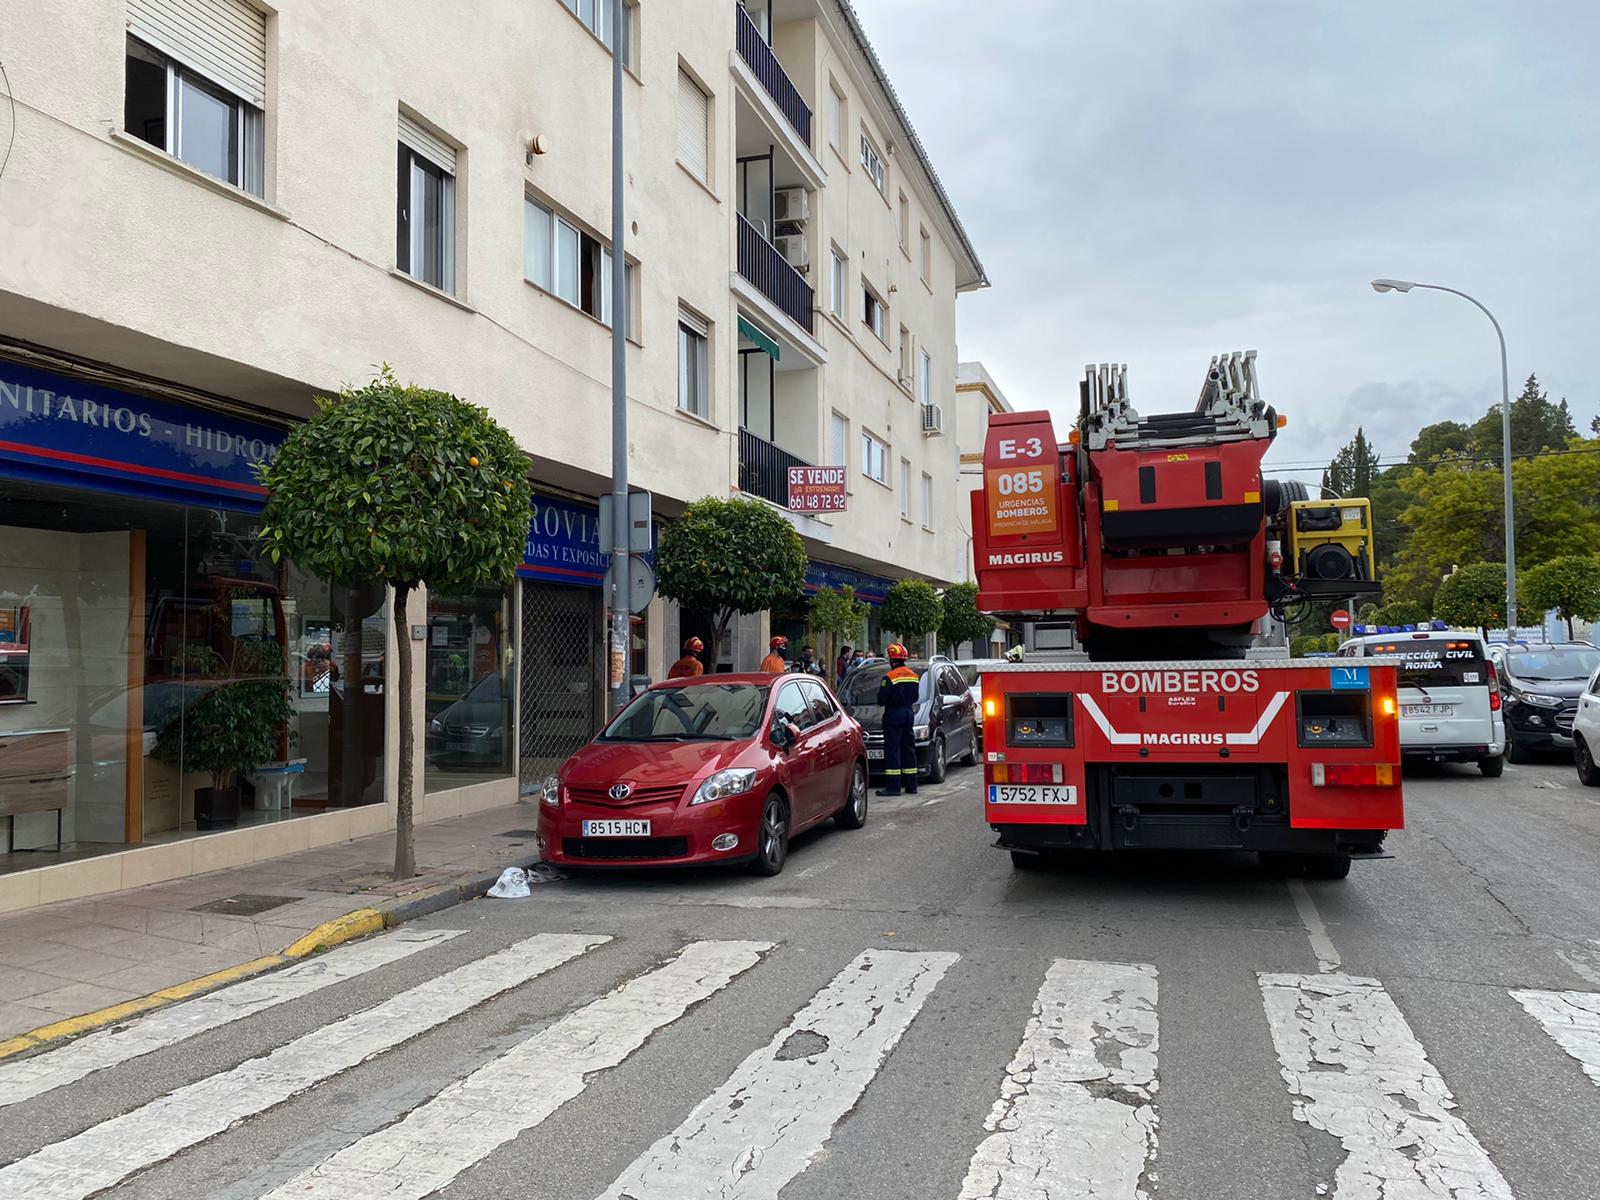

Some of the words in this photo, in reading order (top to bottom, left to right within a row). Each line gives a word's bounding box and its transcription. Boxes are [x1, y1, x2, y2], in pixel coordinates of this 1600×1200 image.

[0, 380, 151, 437] NITARIOS
[999, 437, 1042, 459] E-3
[790, 469, 804, 484] SE
[807, 469, 844, 484] VENDE
[998, 471, 1043, 496] 085
[790, 494, 804, 509] 661
[807, 494, 819, 509] 48
[821, 494, 831, 508] 72
[833, 494, 845, 508] 92
[998, 497, 1045, 509] URGENCIAS
[996, 506, 1048, 519] BOMBEROS
[525, 541, 549, 559] DAS
[551, 545, 559, 560] Y
[988, 551, 1063, 565] MAGIRUS
[1445, 650, 1475, 659] CIVIL
[1405, 661, 1443, 670] RONDA
[1102, 670, 1260, 694] BOMBEROS
[1408, 705, 1431, 714] 8542
[1143, 733, 1224, 746] MAGIRUS
[1000, 787, 1037, 802] 5752
[1042, 788, 1070, 802] FXJ
[590, 822, 622, 834] 8515
[625, 822, 649, 834] HCW
